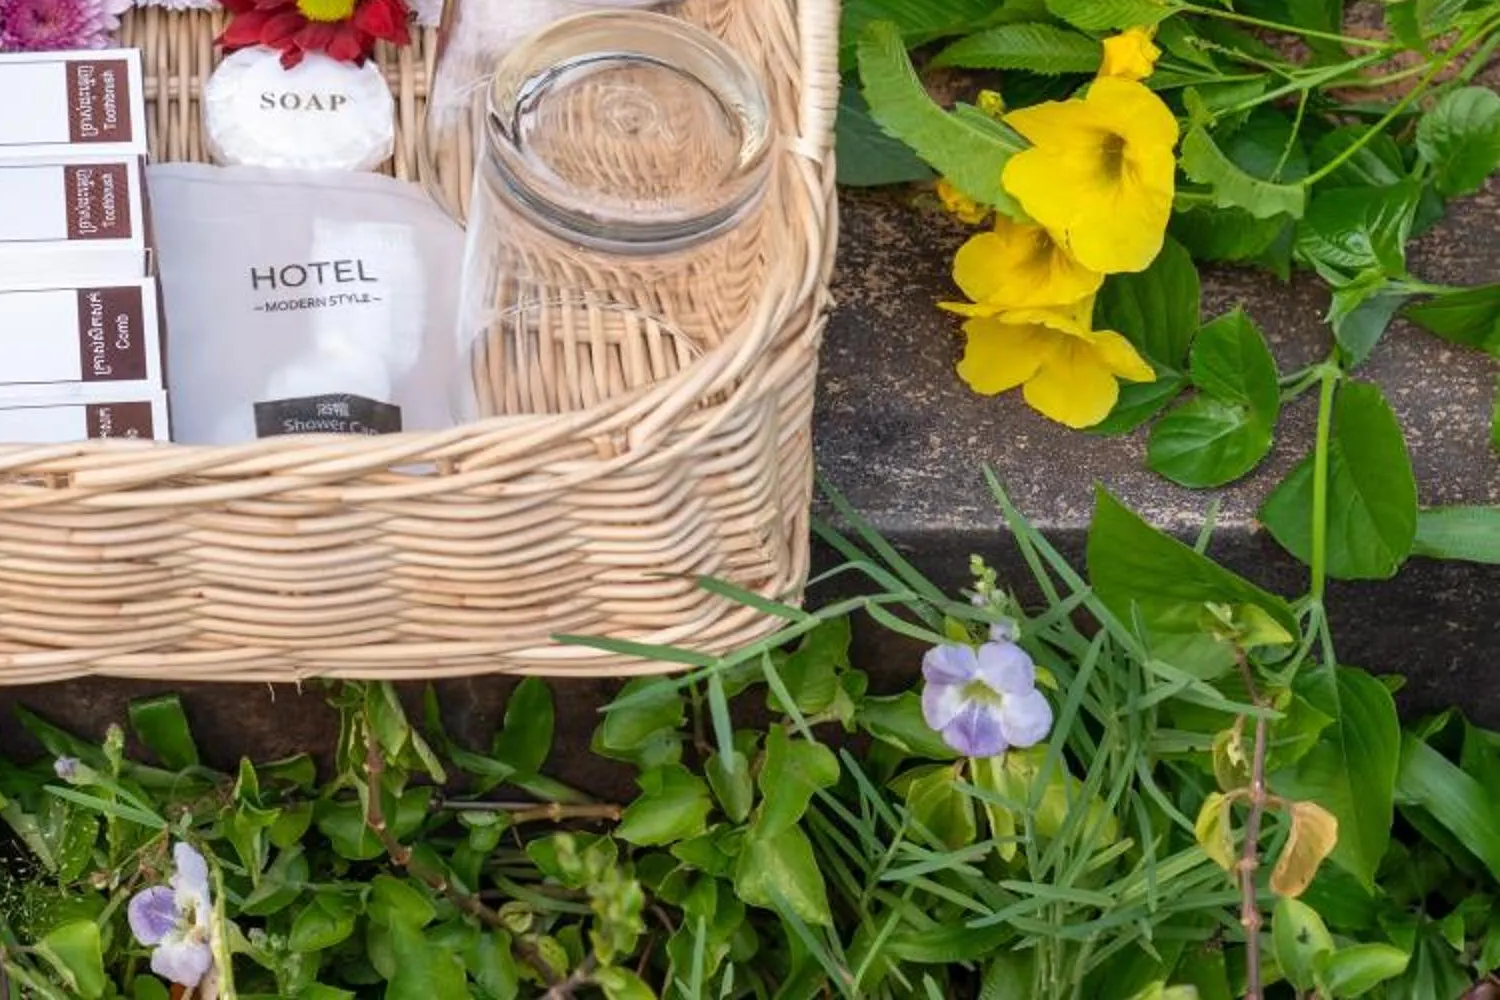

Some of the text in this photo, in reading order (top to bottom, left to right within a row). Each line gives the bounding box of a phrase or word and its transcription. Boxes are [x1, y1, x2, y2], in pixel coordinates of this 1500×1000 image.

[102, 70, 116, 131] Toothbrush
[260, 91, 346, 111] SOAP
[102, 173, 116, 229] Toothbrush
[251, 259, 379, 290] HOTEL
[116, 313, 131, 349] Comb
[284, 418, 346, 433] Shower
